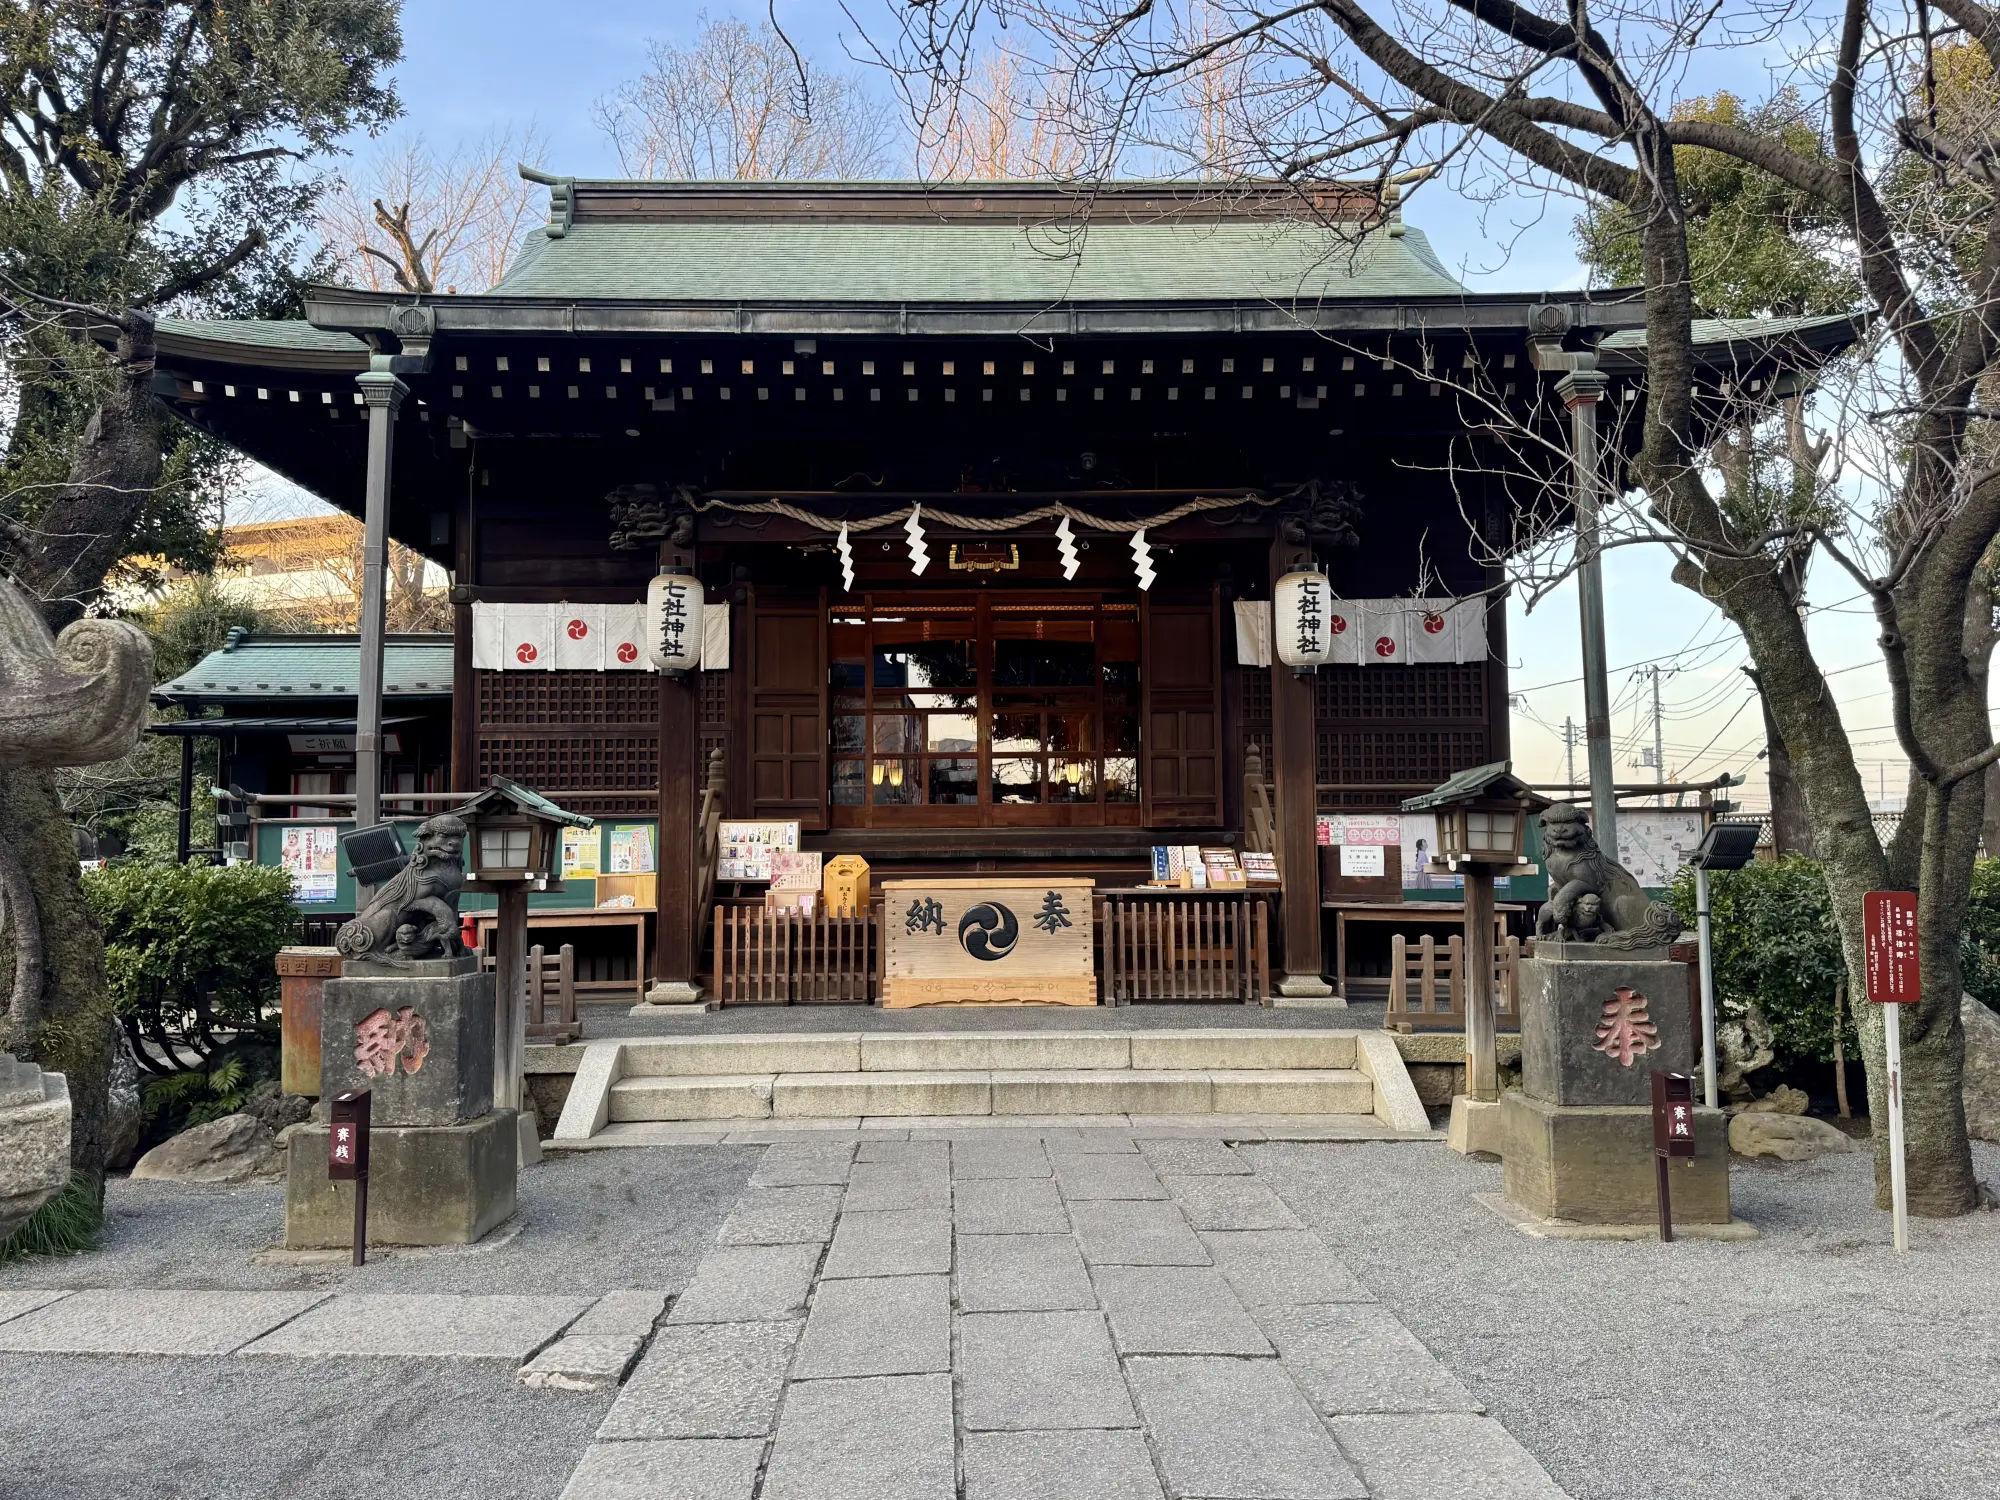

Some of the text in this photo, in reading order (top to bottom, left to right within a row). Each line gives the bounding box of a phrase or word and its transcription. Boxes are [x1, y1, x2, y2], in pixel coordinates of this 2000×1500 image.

[659, 580, 687, 658] 七社神社
[1296, 577, 1322, 655] 七社神社
[905, 896, 948, 936] 納
[1033, 890, 1073, 935] 奉
[1591, 985, 1662, 1067] 奉
[335, 1127, 350, 1159] 賽銭
[1673, 1105, 1689, 1136] 賽銭
